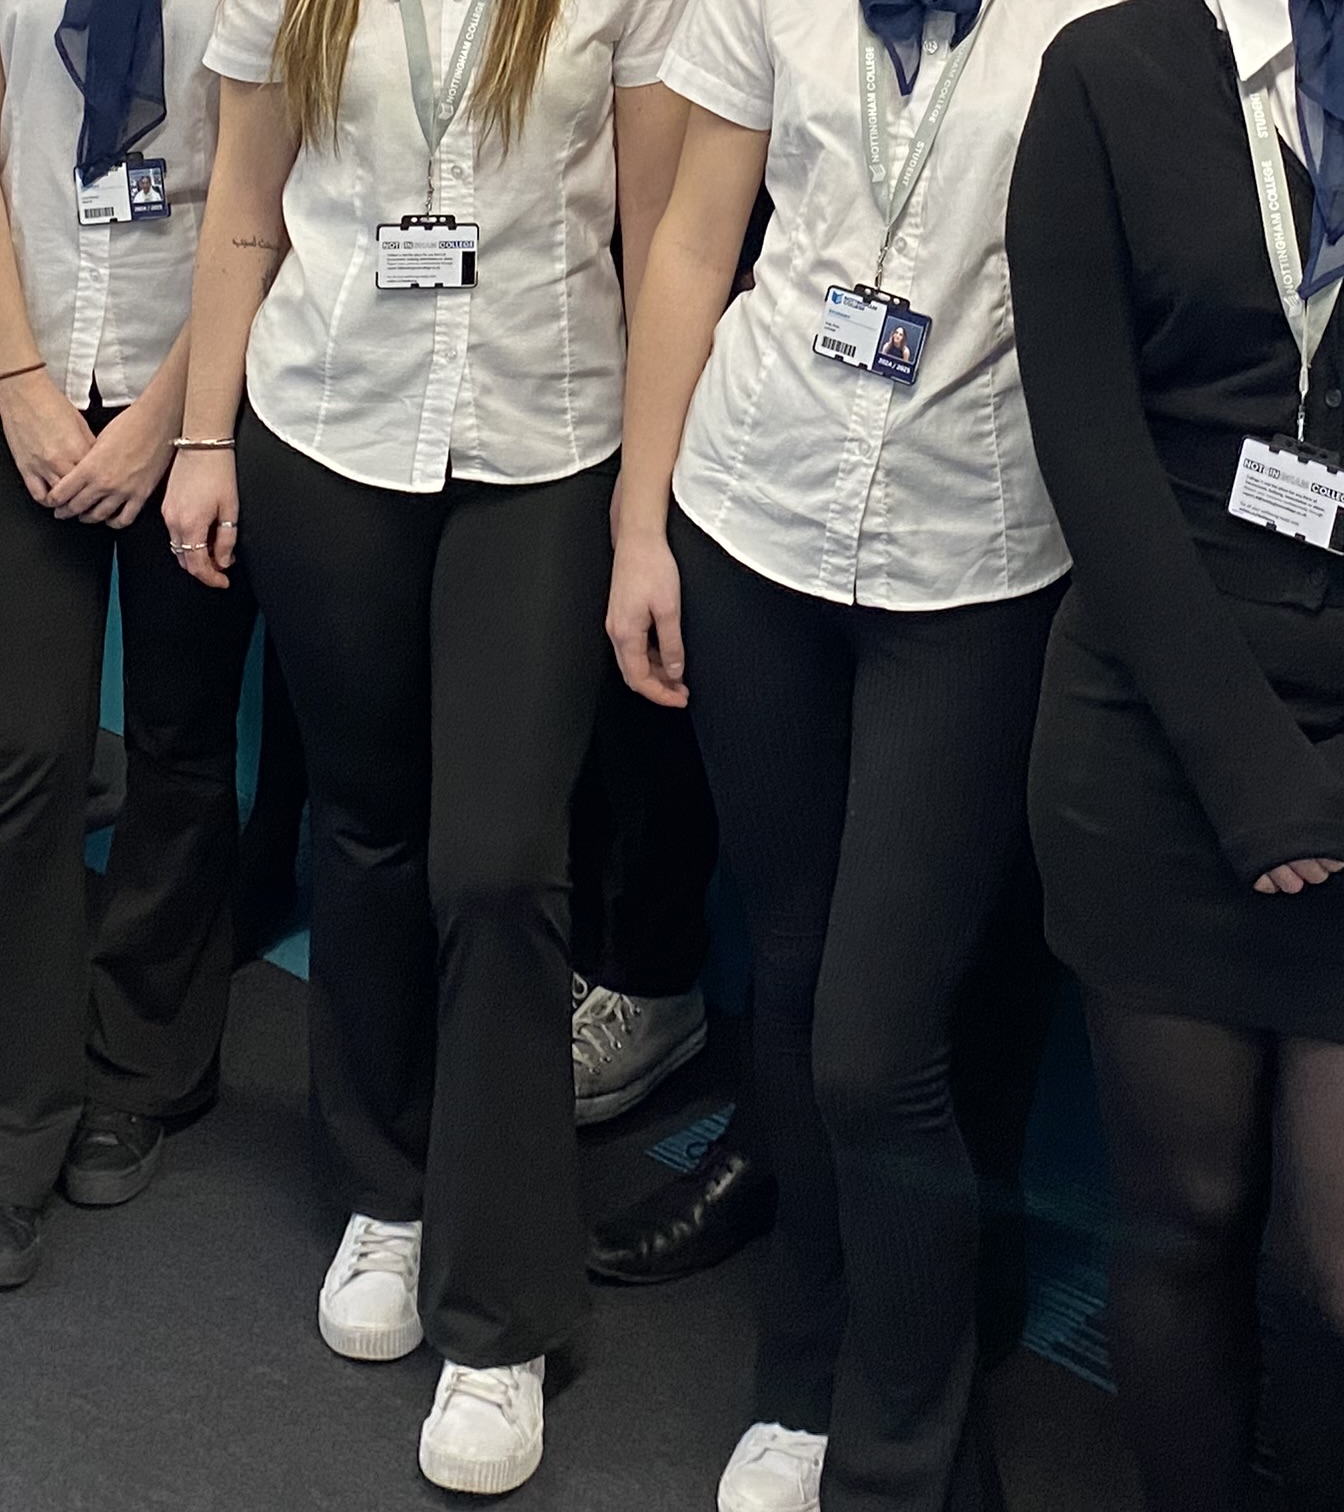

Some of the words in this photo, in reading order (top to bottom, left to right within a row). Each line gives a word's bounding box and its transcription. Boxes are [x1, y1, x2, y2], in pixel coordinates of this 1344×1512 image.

[446, 41, 472, 104] NOTTINGHAM
[465, 1, 486, 41] COLLEGE
[865, 46, 877, 91] COLLEGE
[928, 79, 952, 124] COLLEGE
[1248, 93, 1269, 139] STUDEN
[867, 92, 880, 163] NOTTINGHAM
[901, 140, 926, 187] STUDENT
[1261, 159, 1280, 212] COLLEGE
[1269, 212, 1297, 295] NOTTINGHAM
